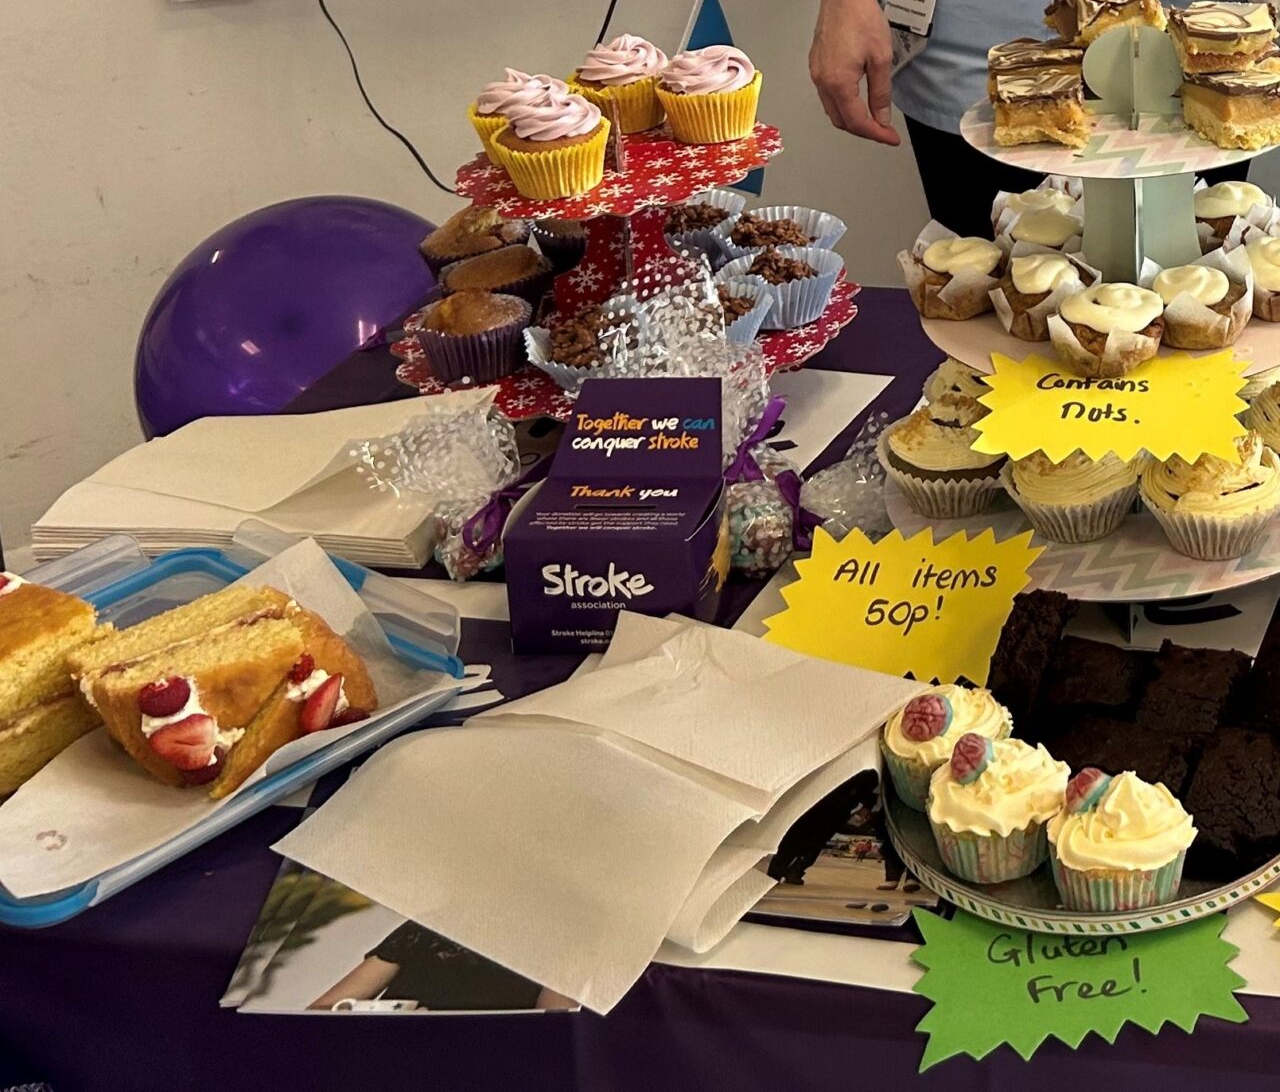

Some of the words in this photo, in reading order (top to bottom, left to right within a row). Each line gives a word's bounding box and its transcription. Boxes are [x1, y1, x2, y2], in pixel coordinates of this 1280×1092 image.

[1036, 372, 1149, 393] Contains
[576, 412, 649, 436] Together
[651, 417, 679, 430] we
[683, 417, 716, 430] can
[572, 436, 646, 457] conquer
[648, 431, 699, 450] stroke
[570, 485, 636, 497] Thank
[639, 488, 679, 500] you
[542, 562, 654, 599] Stroke
[833, 559, 880, 585] All
[912, 558, 998, 590] items
[571, 601, 626, 609] association
[865, 595, 944, 636] 50p!
[988, 932, 1128, 967] Gluten
[1027, 957, 1147, 1004] Free!
